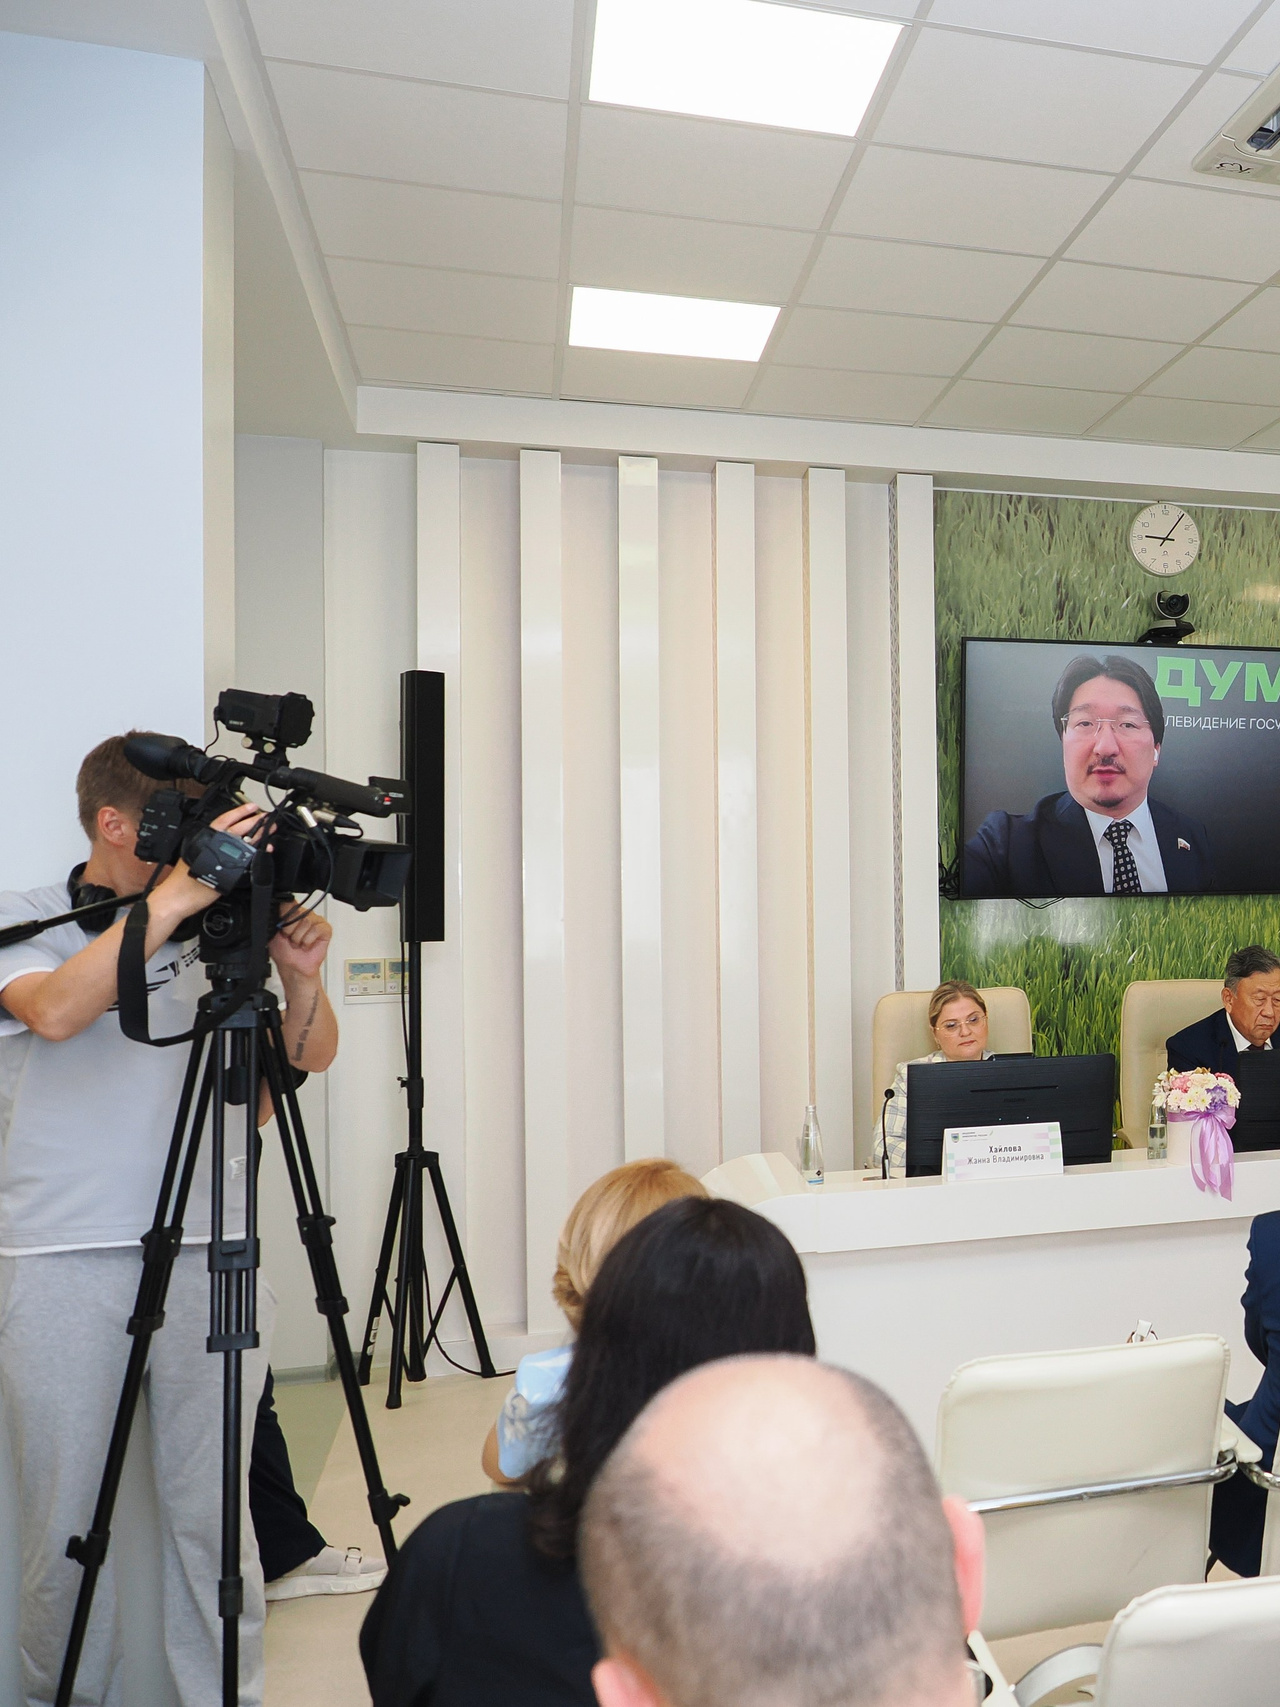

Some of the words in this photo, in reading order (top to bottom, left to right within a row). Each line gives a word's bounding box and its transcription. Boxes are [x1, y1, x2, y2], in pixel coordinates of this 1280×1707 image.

[1164, 715, 1246, 730] ЛЕВИДЕНИЕ
[989, 1145, 1022, 1154] Хайлова
[967, 1156, 990, 1165] Жанна
[992, 1153, 1044, 1164] Владимировна
